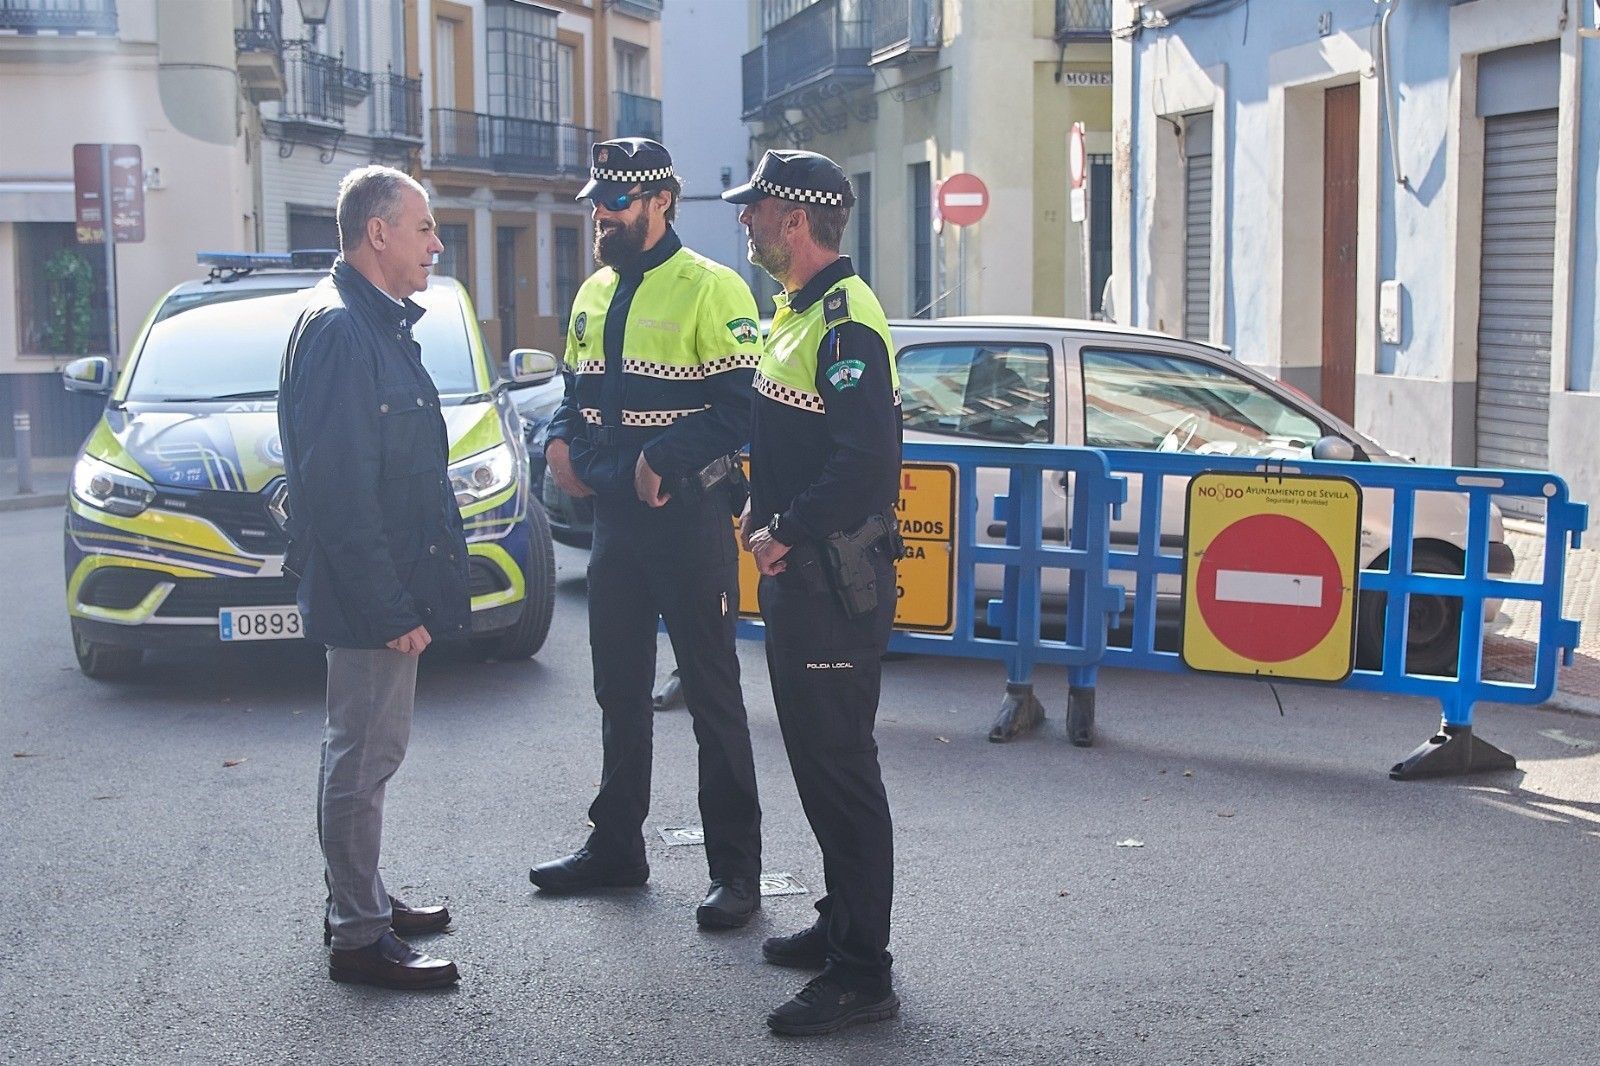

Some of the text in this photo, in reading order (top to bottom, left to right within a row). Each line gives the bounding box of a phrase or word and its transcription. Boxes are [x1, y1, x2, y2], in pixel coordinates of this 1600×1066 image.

[1246, 486, 1305, 497] AYUNTAMIENTO
[1320, 489, 1349, 499] SEVILLA
[1266, 497, 1295, 505] Seguridad
[238, 613, 300, 636] 0893
